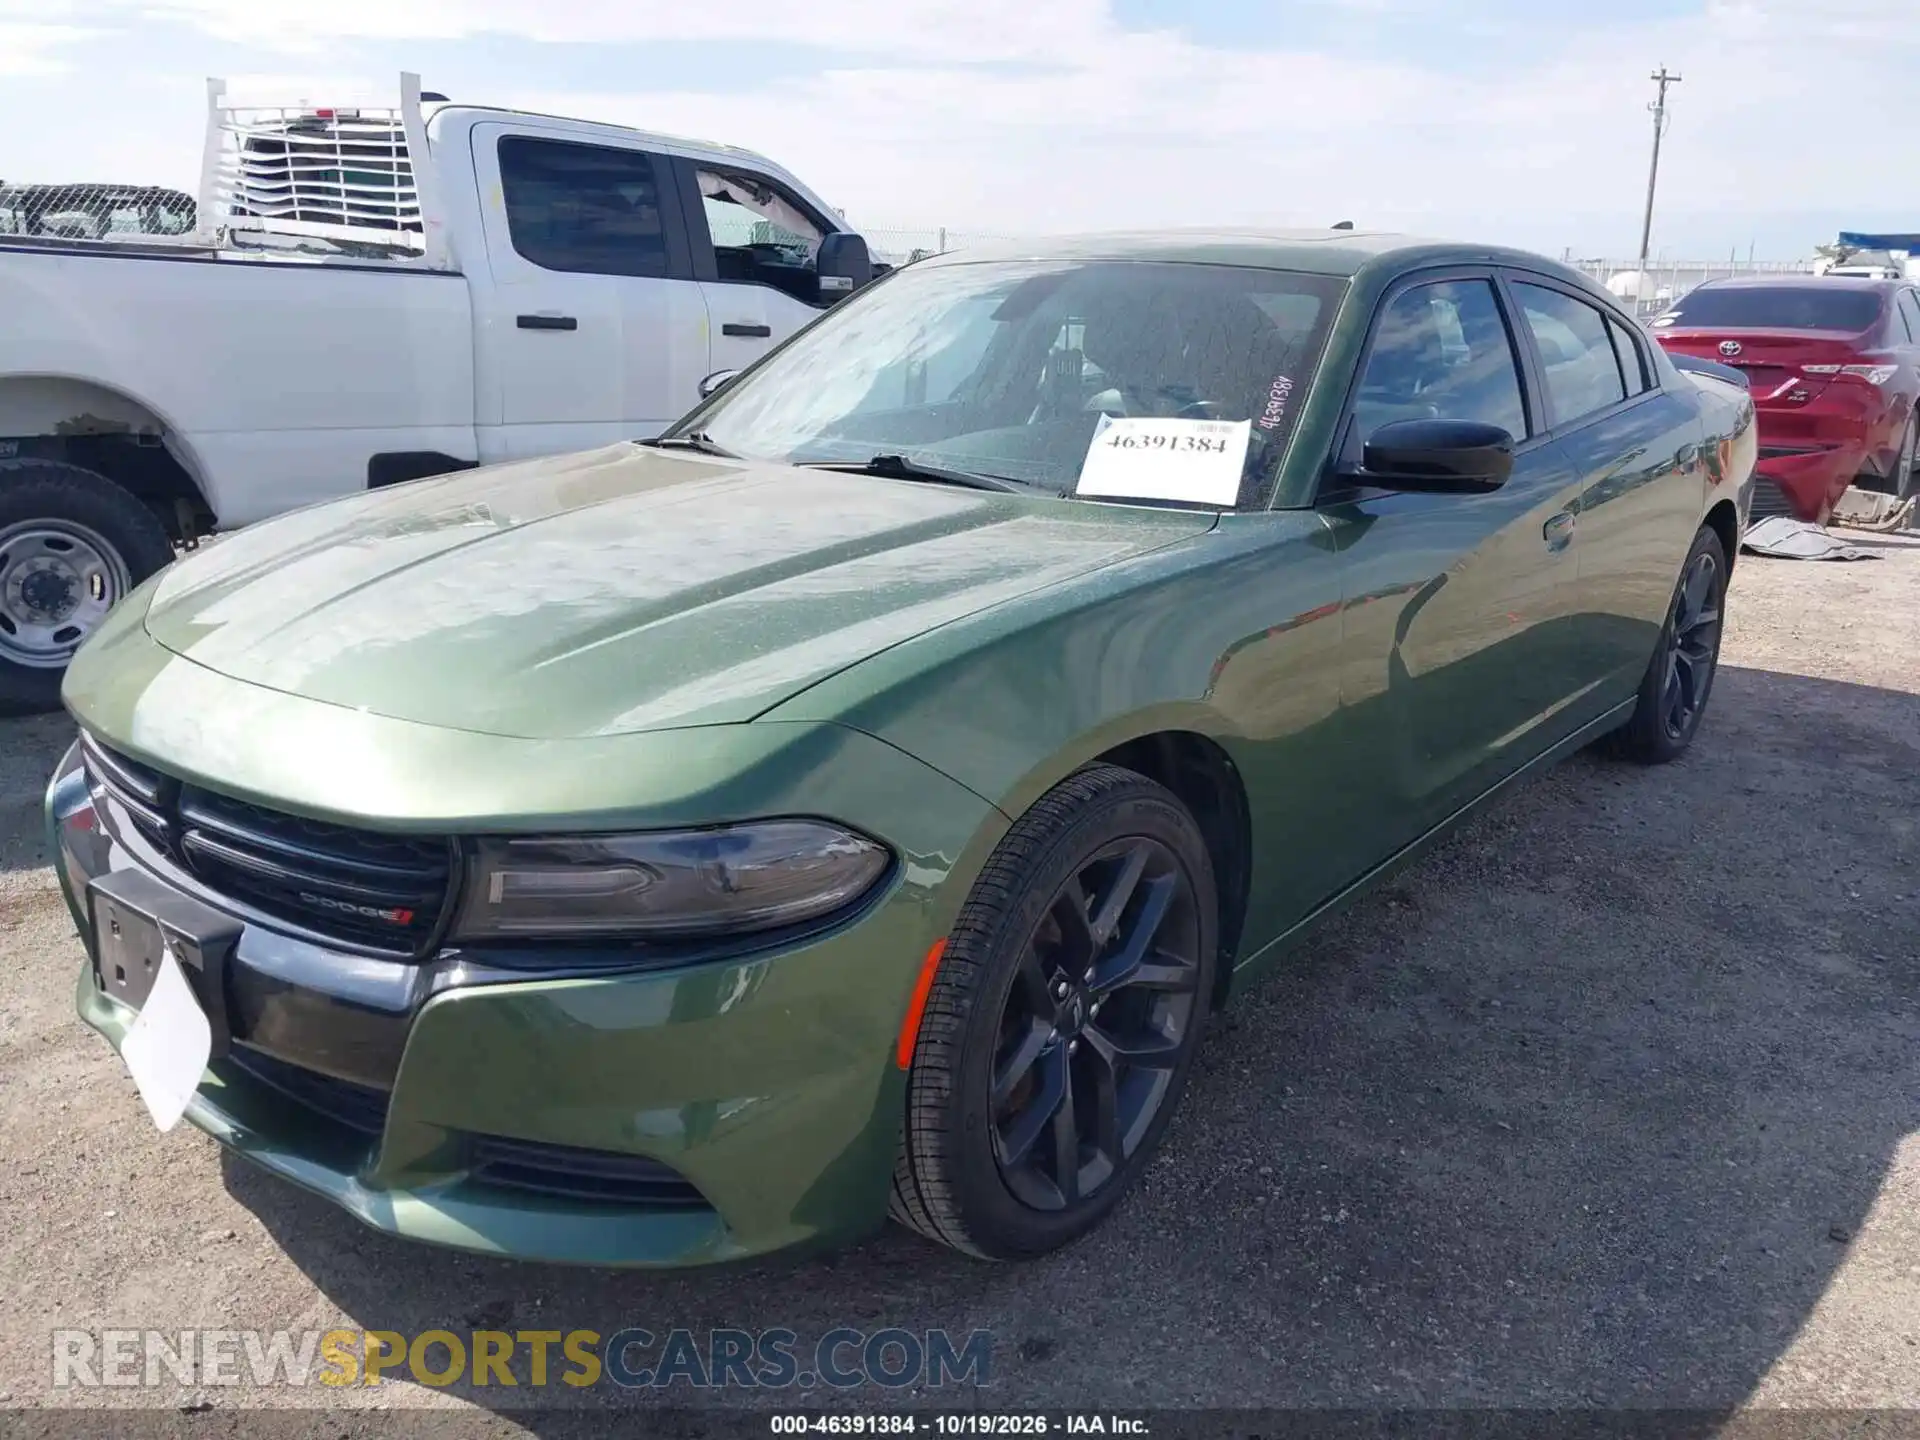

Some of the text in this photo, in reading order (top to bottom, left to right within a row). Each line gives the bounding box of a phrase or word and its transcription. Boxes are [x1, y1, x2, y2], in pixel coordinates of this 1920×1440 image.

[1260, 375, 1295, 429] 46391384
[1107, 434, 1226, 453] 46391384
[300, 892, 400, 920] DODGE
